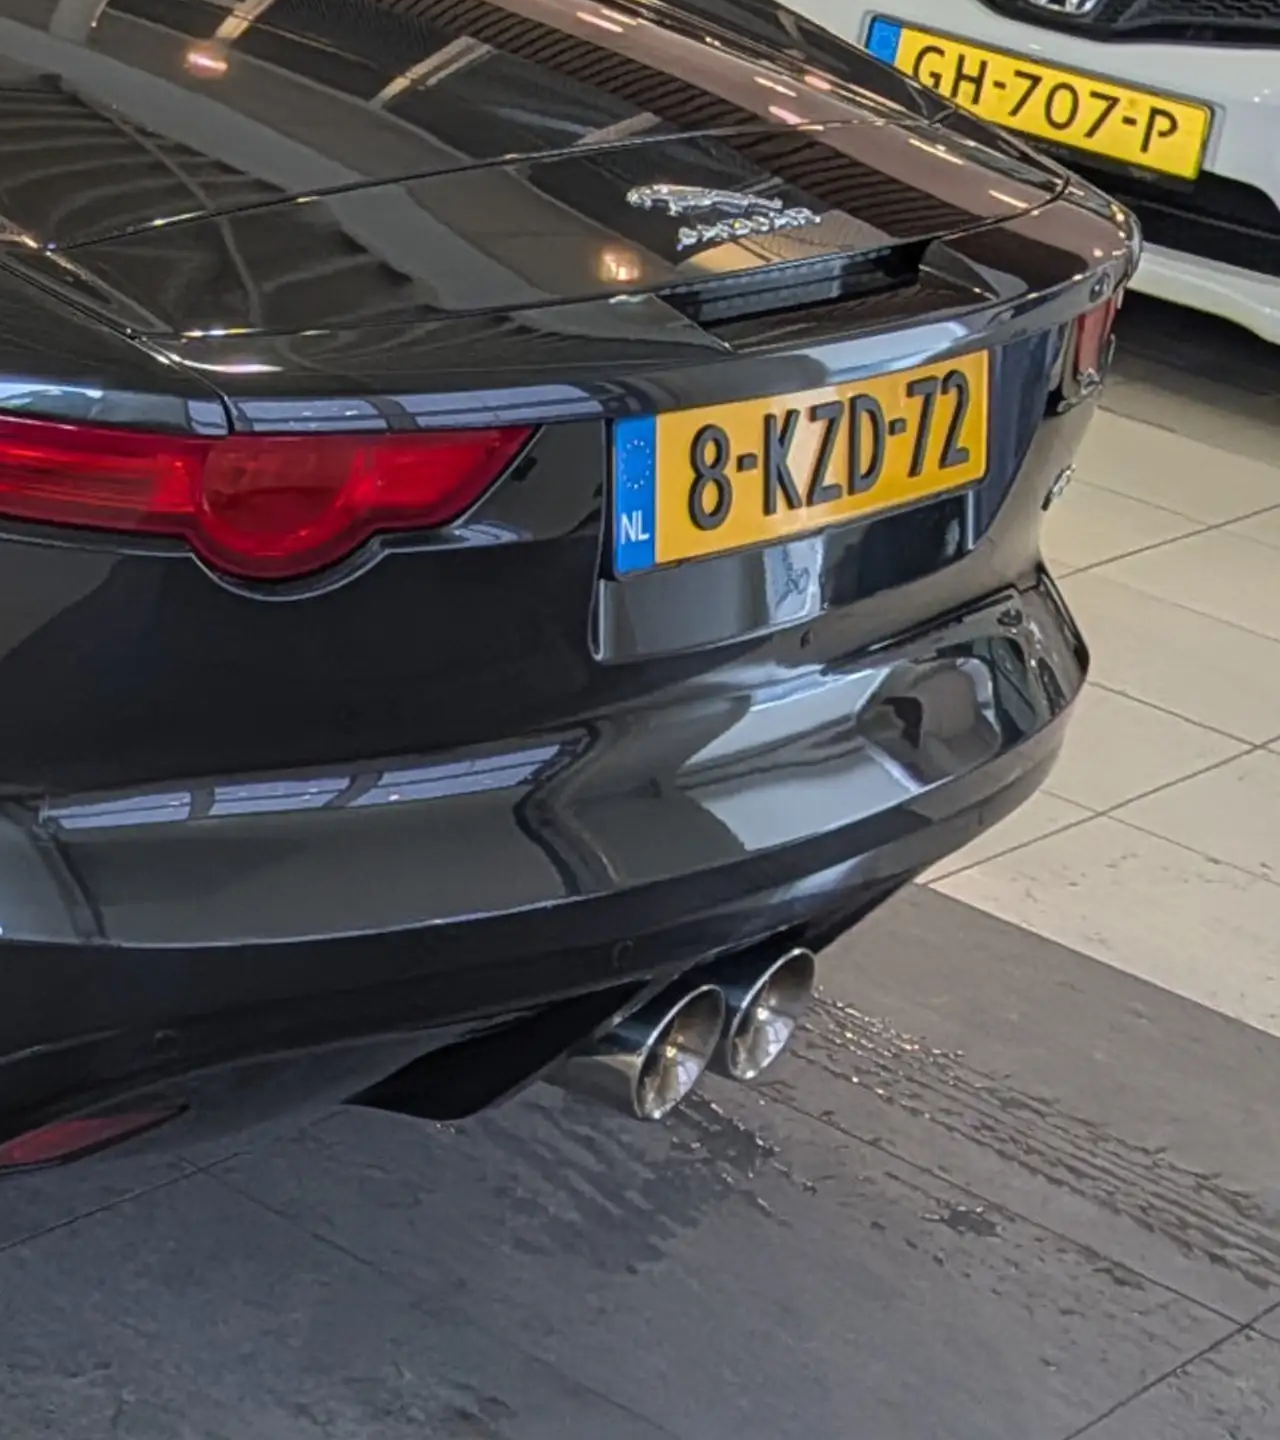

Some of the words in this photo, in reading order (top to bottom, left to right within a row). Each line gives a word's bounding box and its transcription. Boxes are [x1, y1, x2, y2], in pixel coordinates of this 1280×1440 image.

[912, 45, 1179, 154] GH-707-P
[688, 369, 971, 531] 8-KZD-72
[620, 509, 650, 545] NL
